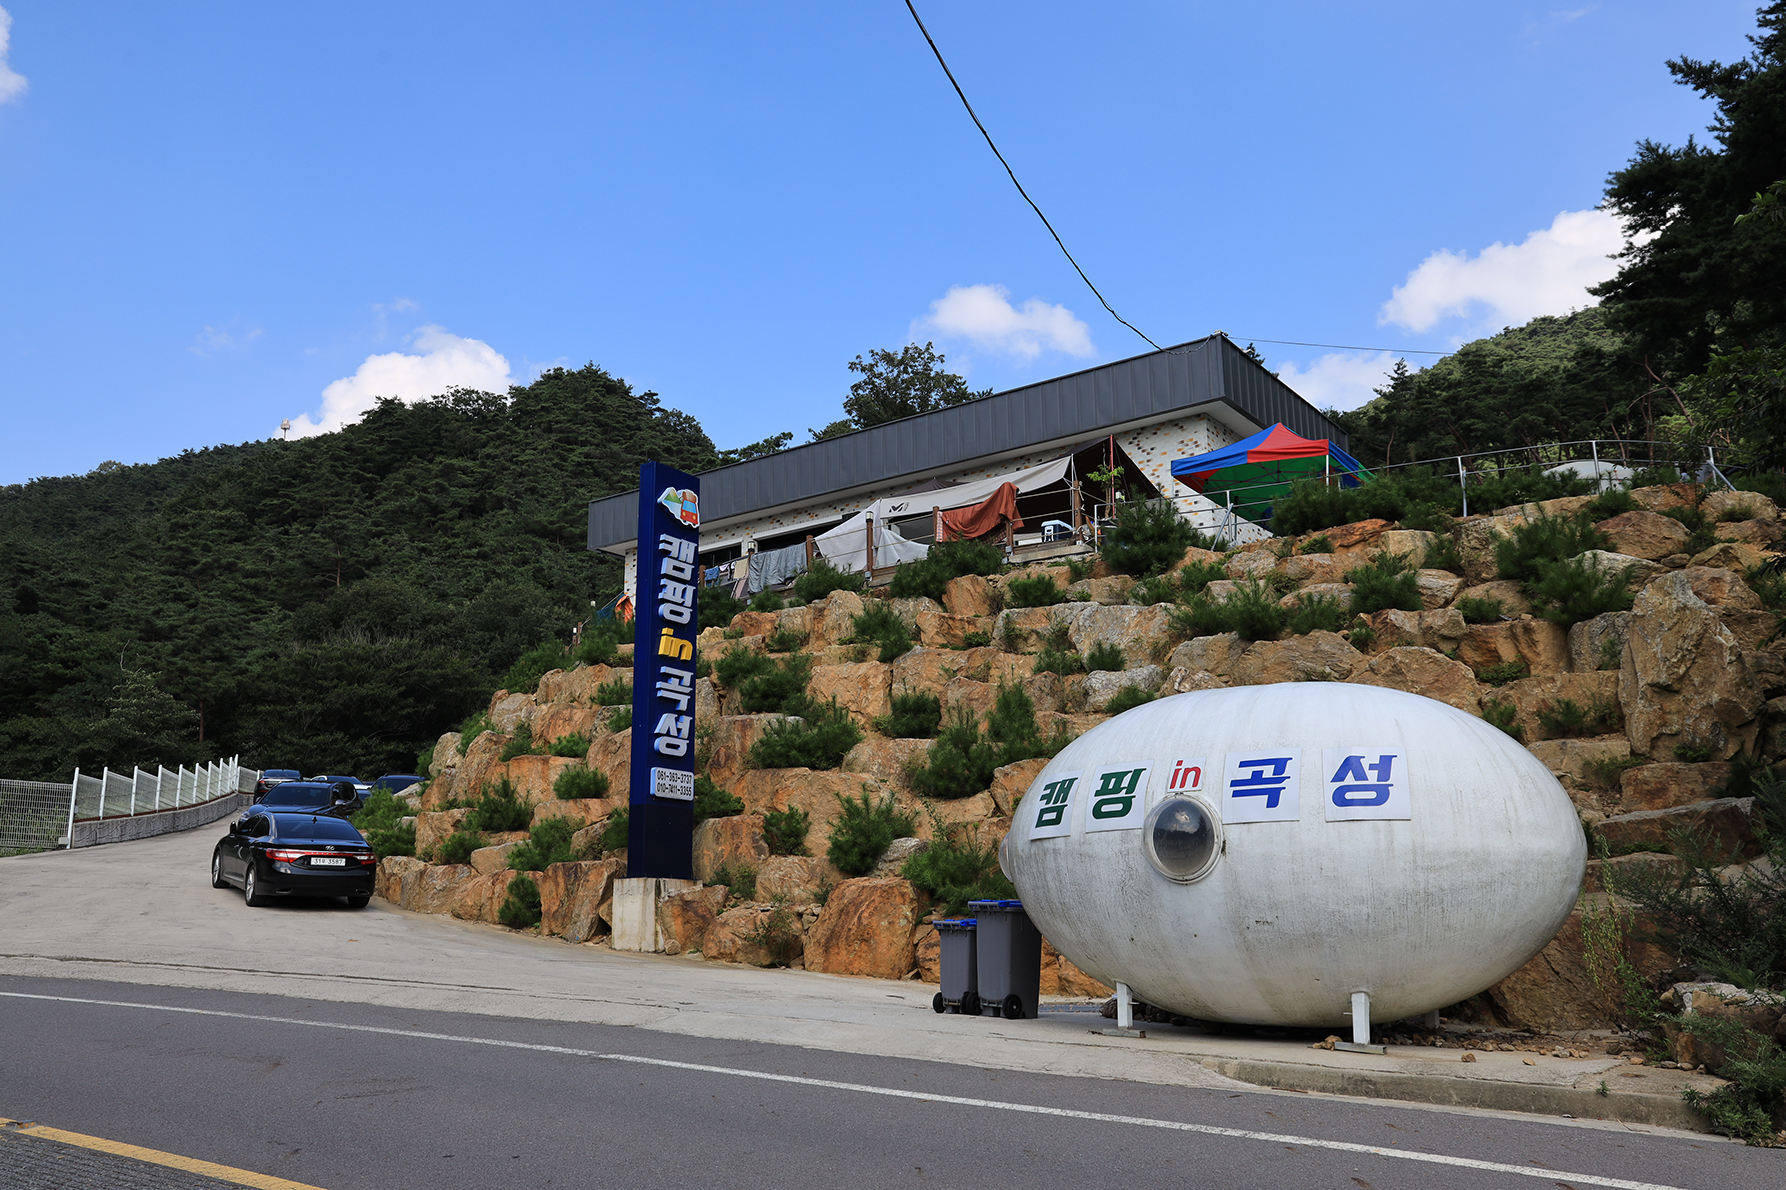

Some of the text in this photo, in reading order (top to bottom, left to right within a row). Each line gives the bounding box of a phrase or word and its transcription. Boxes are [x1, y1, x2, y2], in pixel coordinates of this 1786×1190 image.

[654, 533, 697, 757] 캠핑 in 곡성
[656, 770, 693, 785] 061-363-3737
[1035, 754, 1398, 829] 캠핑 in 곡성
